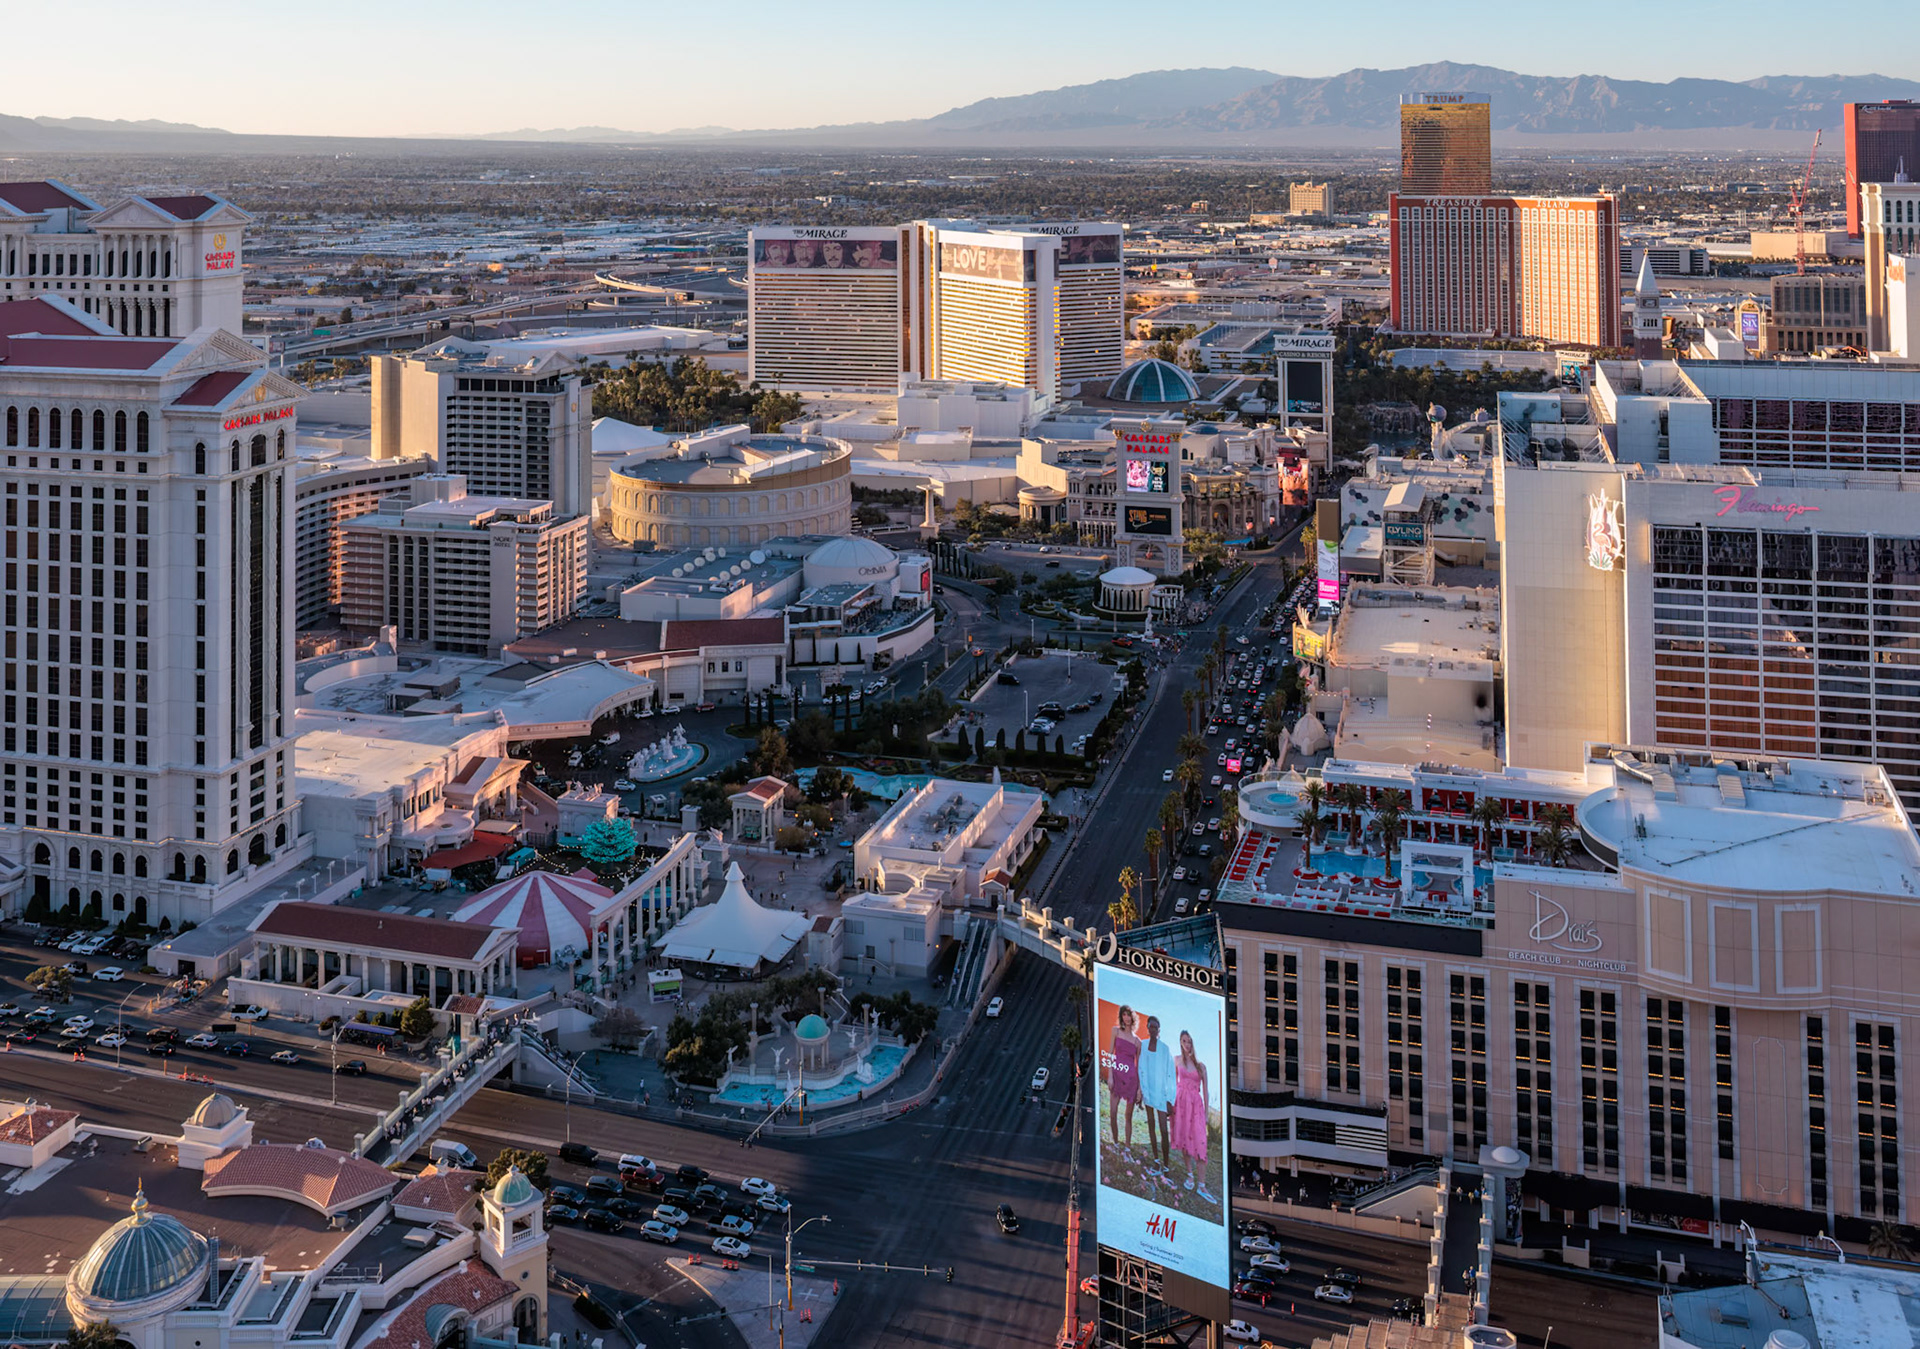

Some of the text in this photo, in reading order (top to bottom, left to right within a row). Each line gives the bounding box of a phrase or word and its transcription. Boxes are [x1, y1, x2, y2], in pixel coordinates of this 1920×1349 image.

[1425, 95, 1465, 103] TRUMP
[1424, 199, 1570, 208] TREASURE ISLAND
[796, 229, 848, 239] MIRAGE
[1038, 226, 1079, 236] MIRAGE
[205, 251, 236, 262] CAESARS
[953, 247, 986, 271] LOVE
[206, 260, 234, 271] PALACE
[1743, 318, 1758, 328] SIX
[1281, 339, 1332, 348] MIRAGE
[224, 406, 294, 431] CAESARS PALACE
[1124, 434, 1172, 444] CAESARS
[1126, 444, 1170, 455] PALACE
[1712, 485, 1821, 522] Flamingo
[858, 565, 888, 576] OMNIA
[1528, 889, 1603, 953] Drai's
[1508, 951, 1627, 972] BEACH CLUB NIGHTCLUB
[1101, 1057, 1130, 1073] $34.99
[1146, 1212, 1177, 1243] H&M
